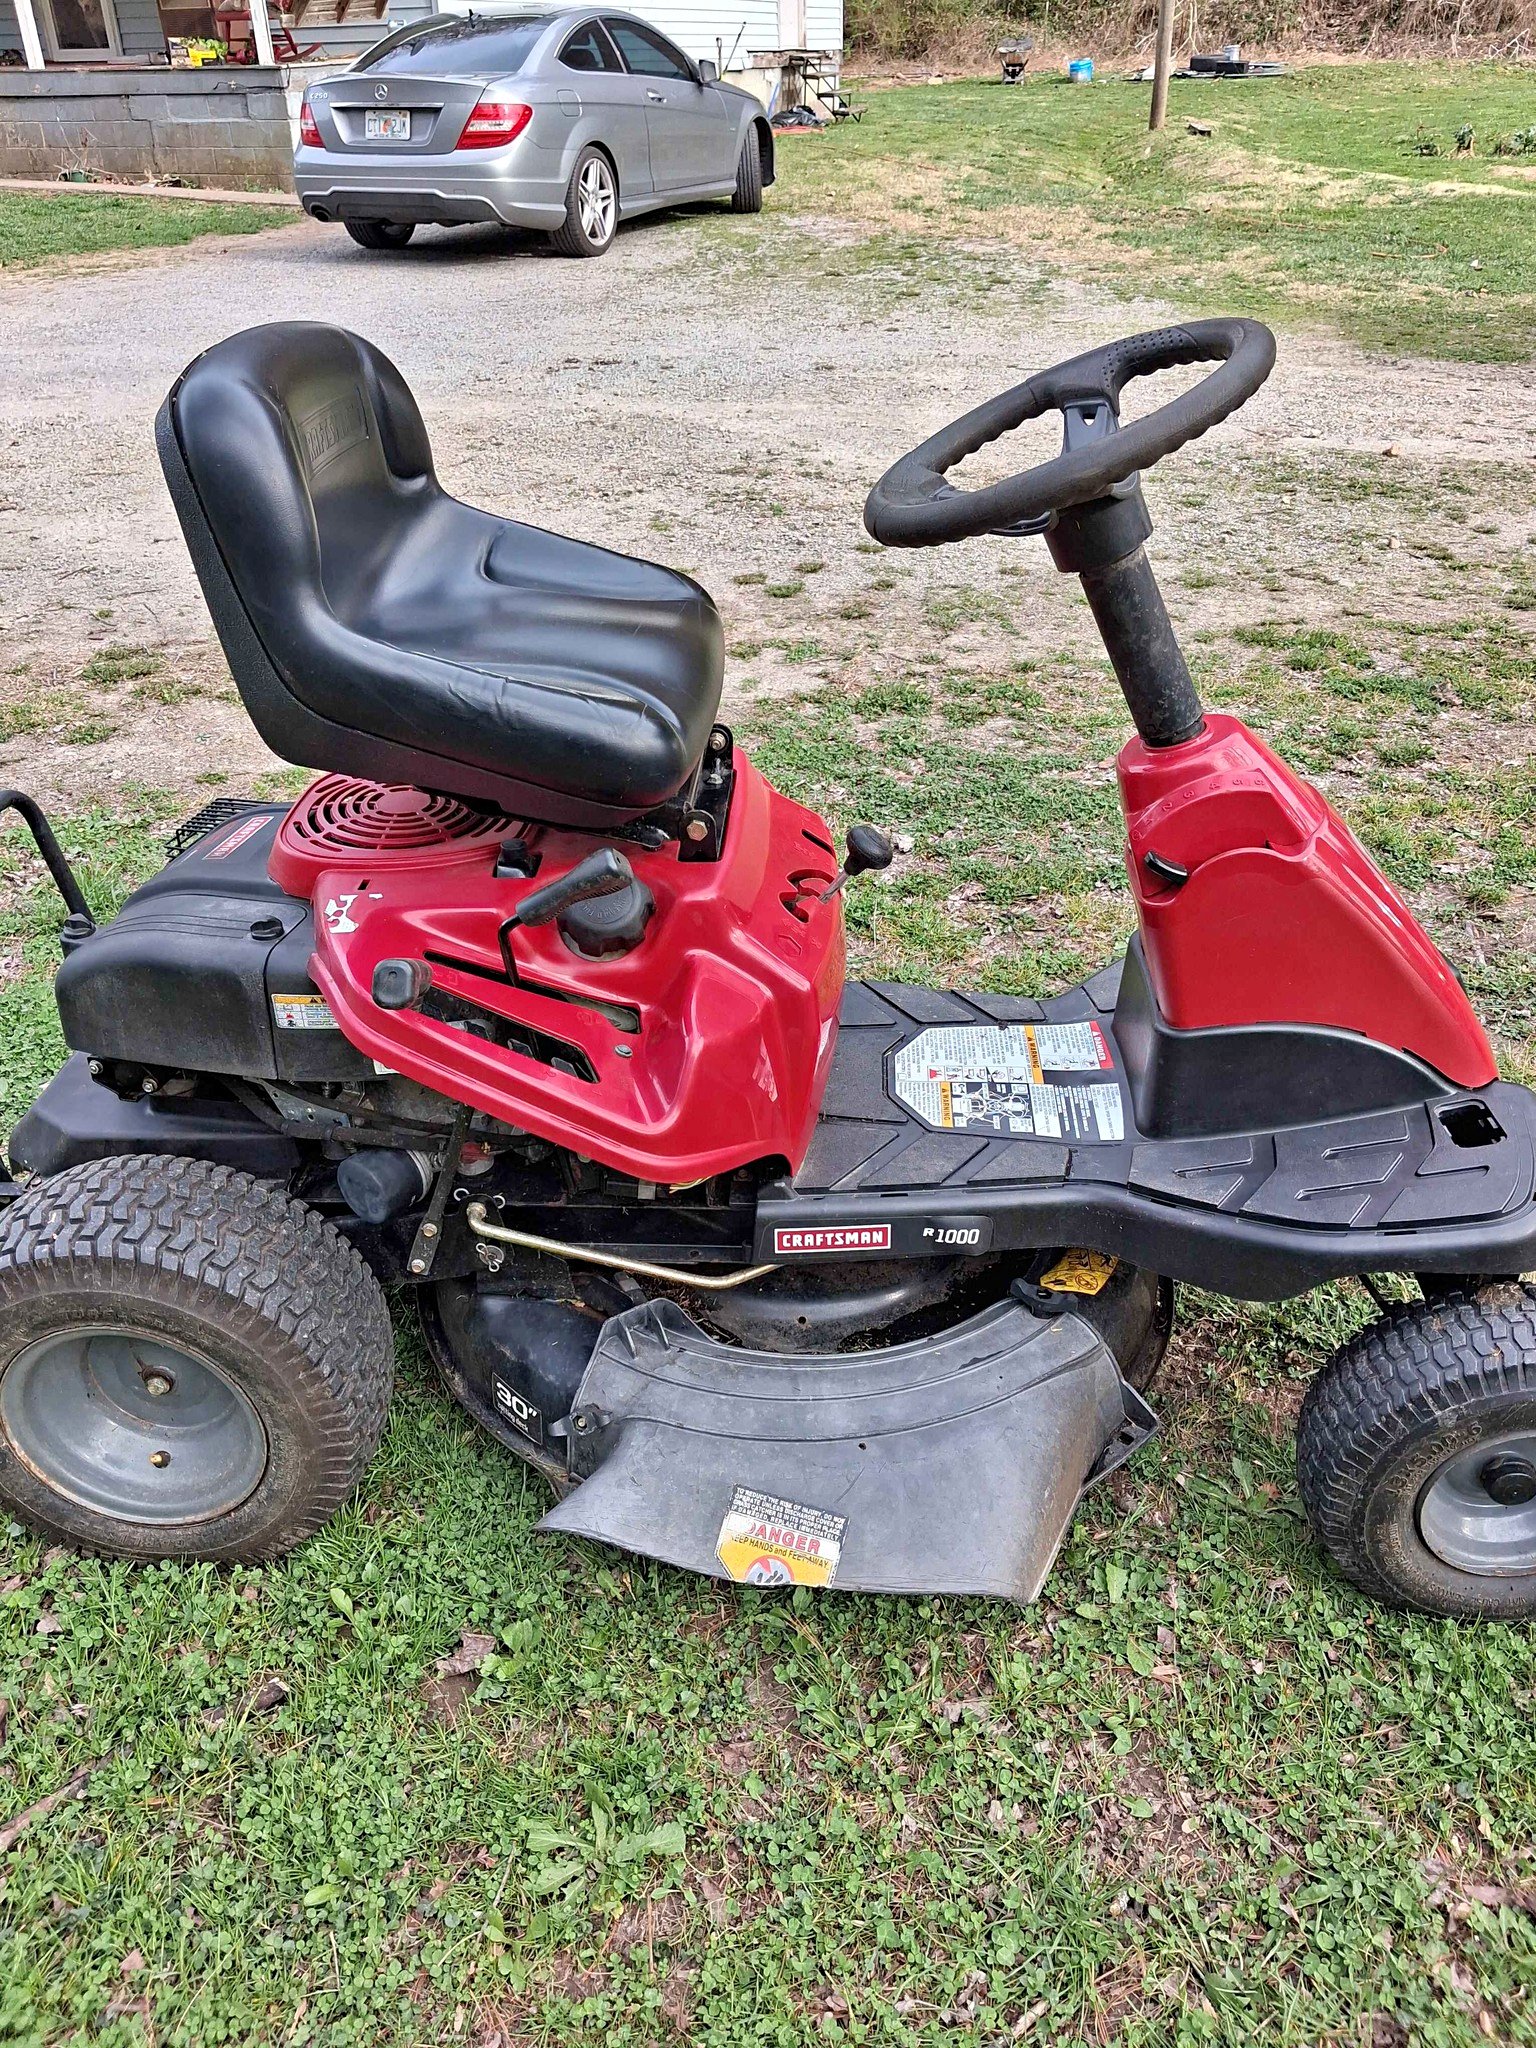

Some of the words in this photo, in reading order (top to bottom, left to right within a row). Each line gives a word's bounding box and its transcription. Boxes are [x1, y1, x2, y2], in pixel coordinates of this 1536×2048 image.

[1027, 1041, 1040, 1069] WARNING
[941, 1092, 951, 1122] WARNING
[782, 1230, 883, 1248] CRAFTSMAN
[734, 1493, 761, 1506] OPERATE
[762, 1501, 784, 1512] UNLESS
[816, 1518, 835, 1528] COVER
[745, 1490, 768, 1501] REDUCE
[768, 1496, 780, 1504] THE
[780, 1500, 794, 1508] RISK
[751, 1504, 776, 1516] CATCHER
[790, 1514, 800, 1524] ITS
[799, 1518, 822, 1530] PROPER
[770, 1516, 798, 1530] REPLACE
[732, 1534, 748, 1544] EEP
[749, 1539, 774, 1553] HANDS
[774, 1547, 788, 1557] and
